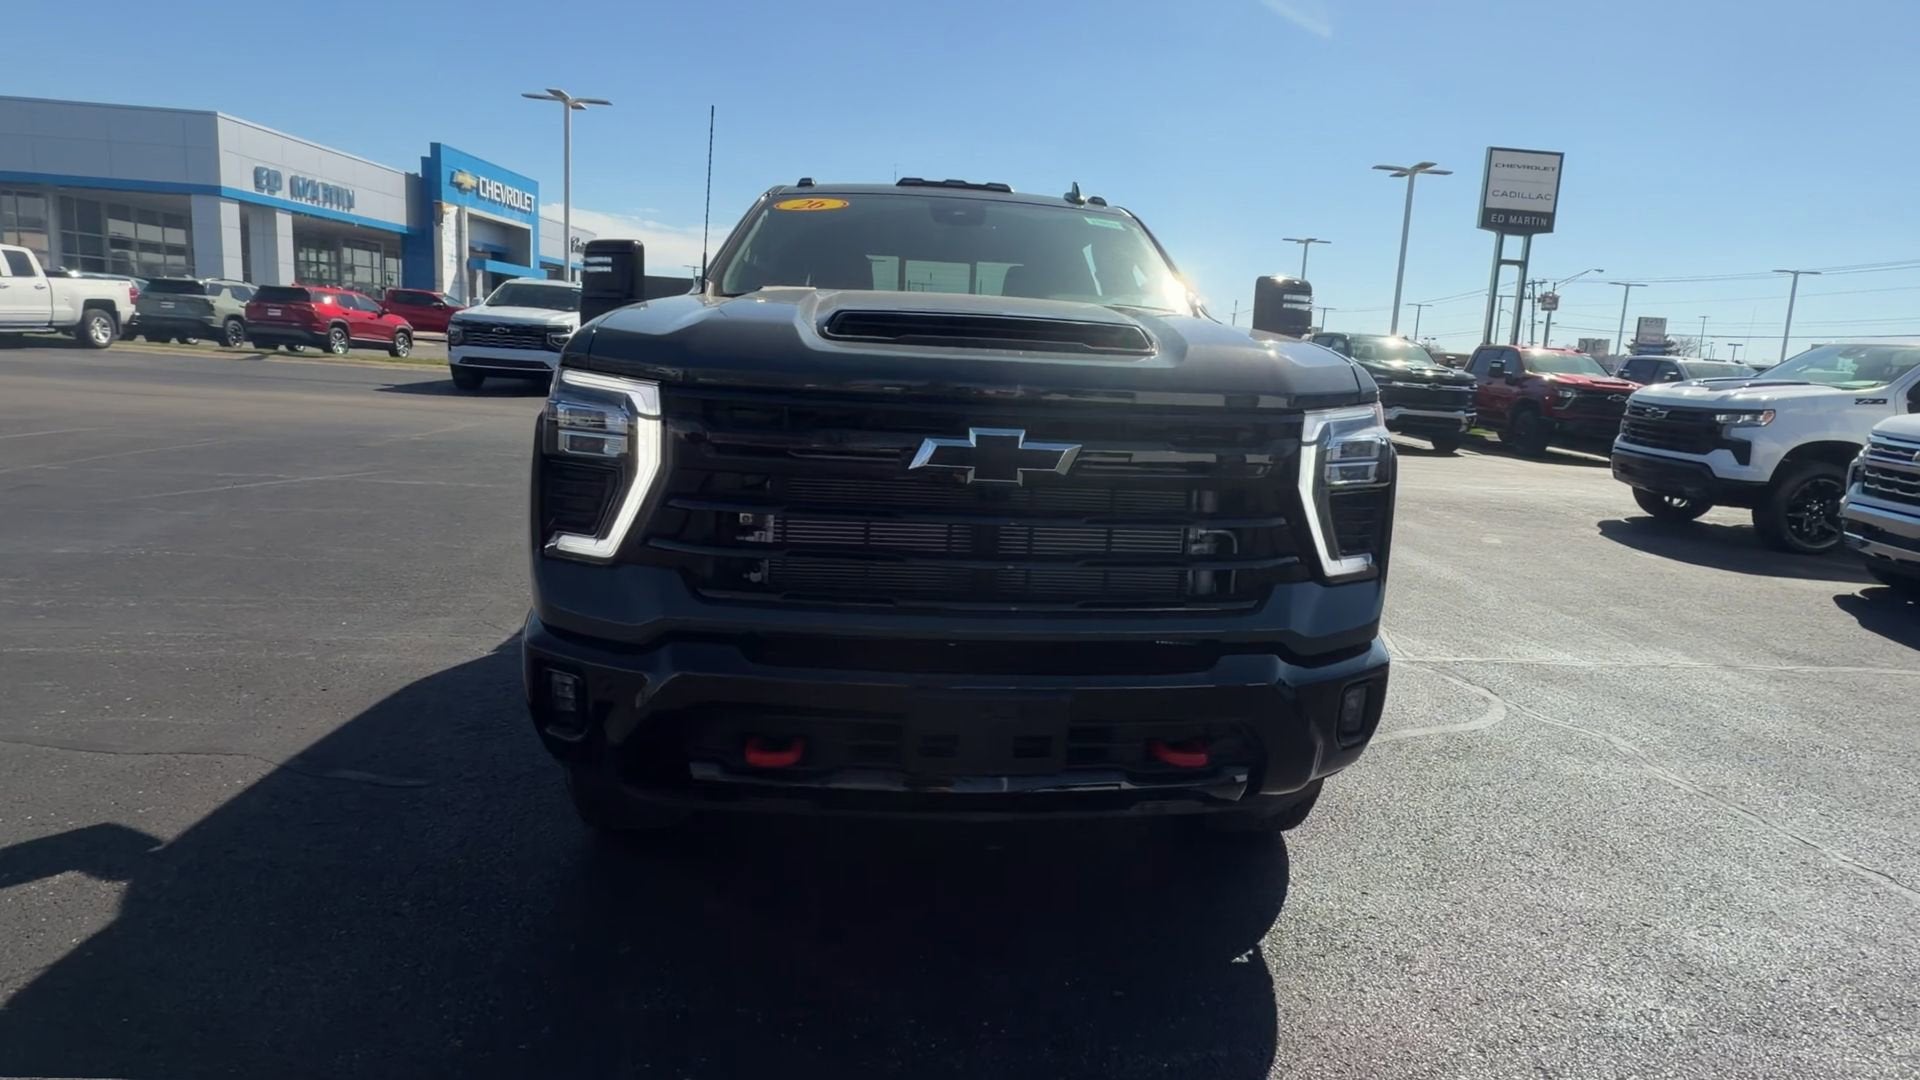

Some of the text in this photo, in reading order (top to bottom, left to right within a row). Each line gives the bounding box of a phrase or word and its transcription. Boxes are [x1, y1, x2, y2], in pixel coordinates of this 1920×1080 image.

[1494, 162, 1556, 172] CHEVROLET
[479, 175, 536, 213] CHEVROLET
[1491, 189, 1552, 201] CADILLAC
[1490, 213, 1547, 227] ED MARTIN
